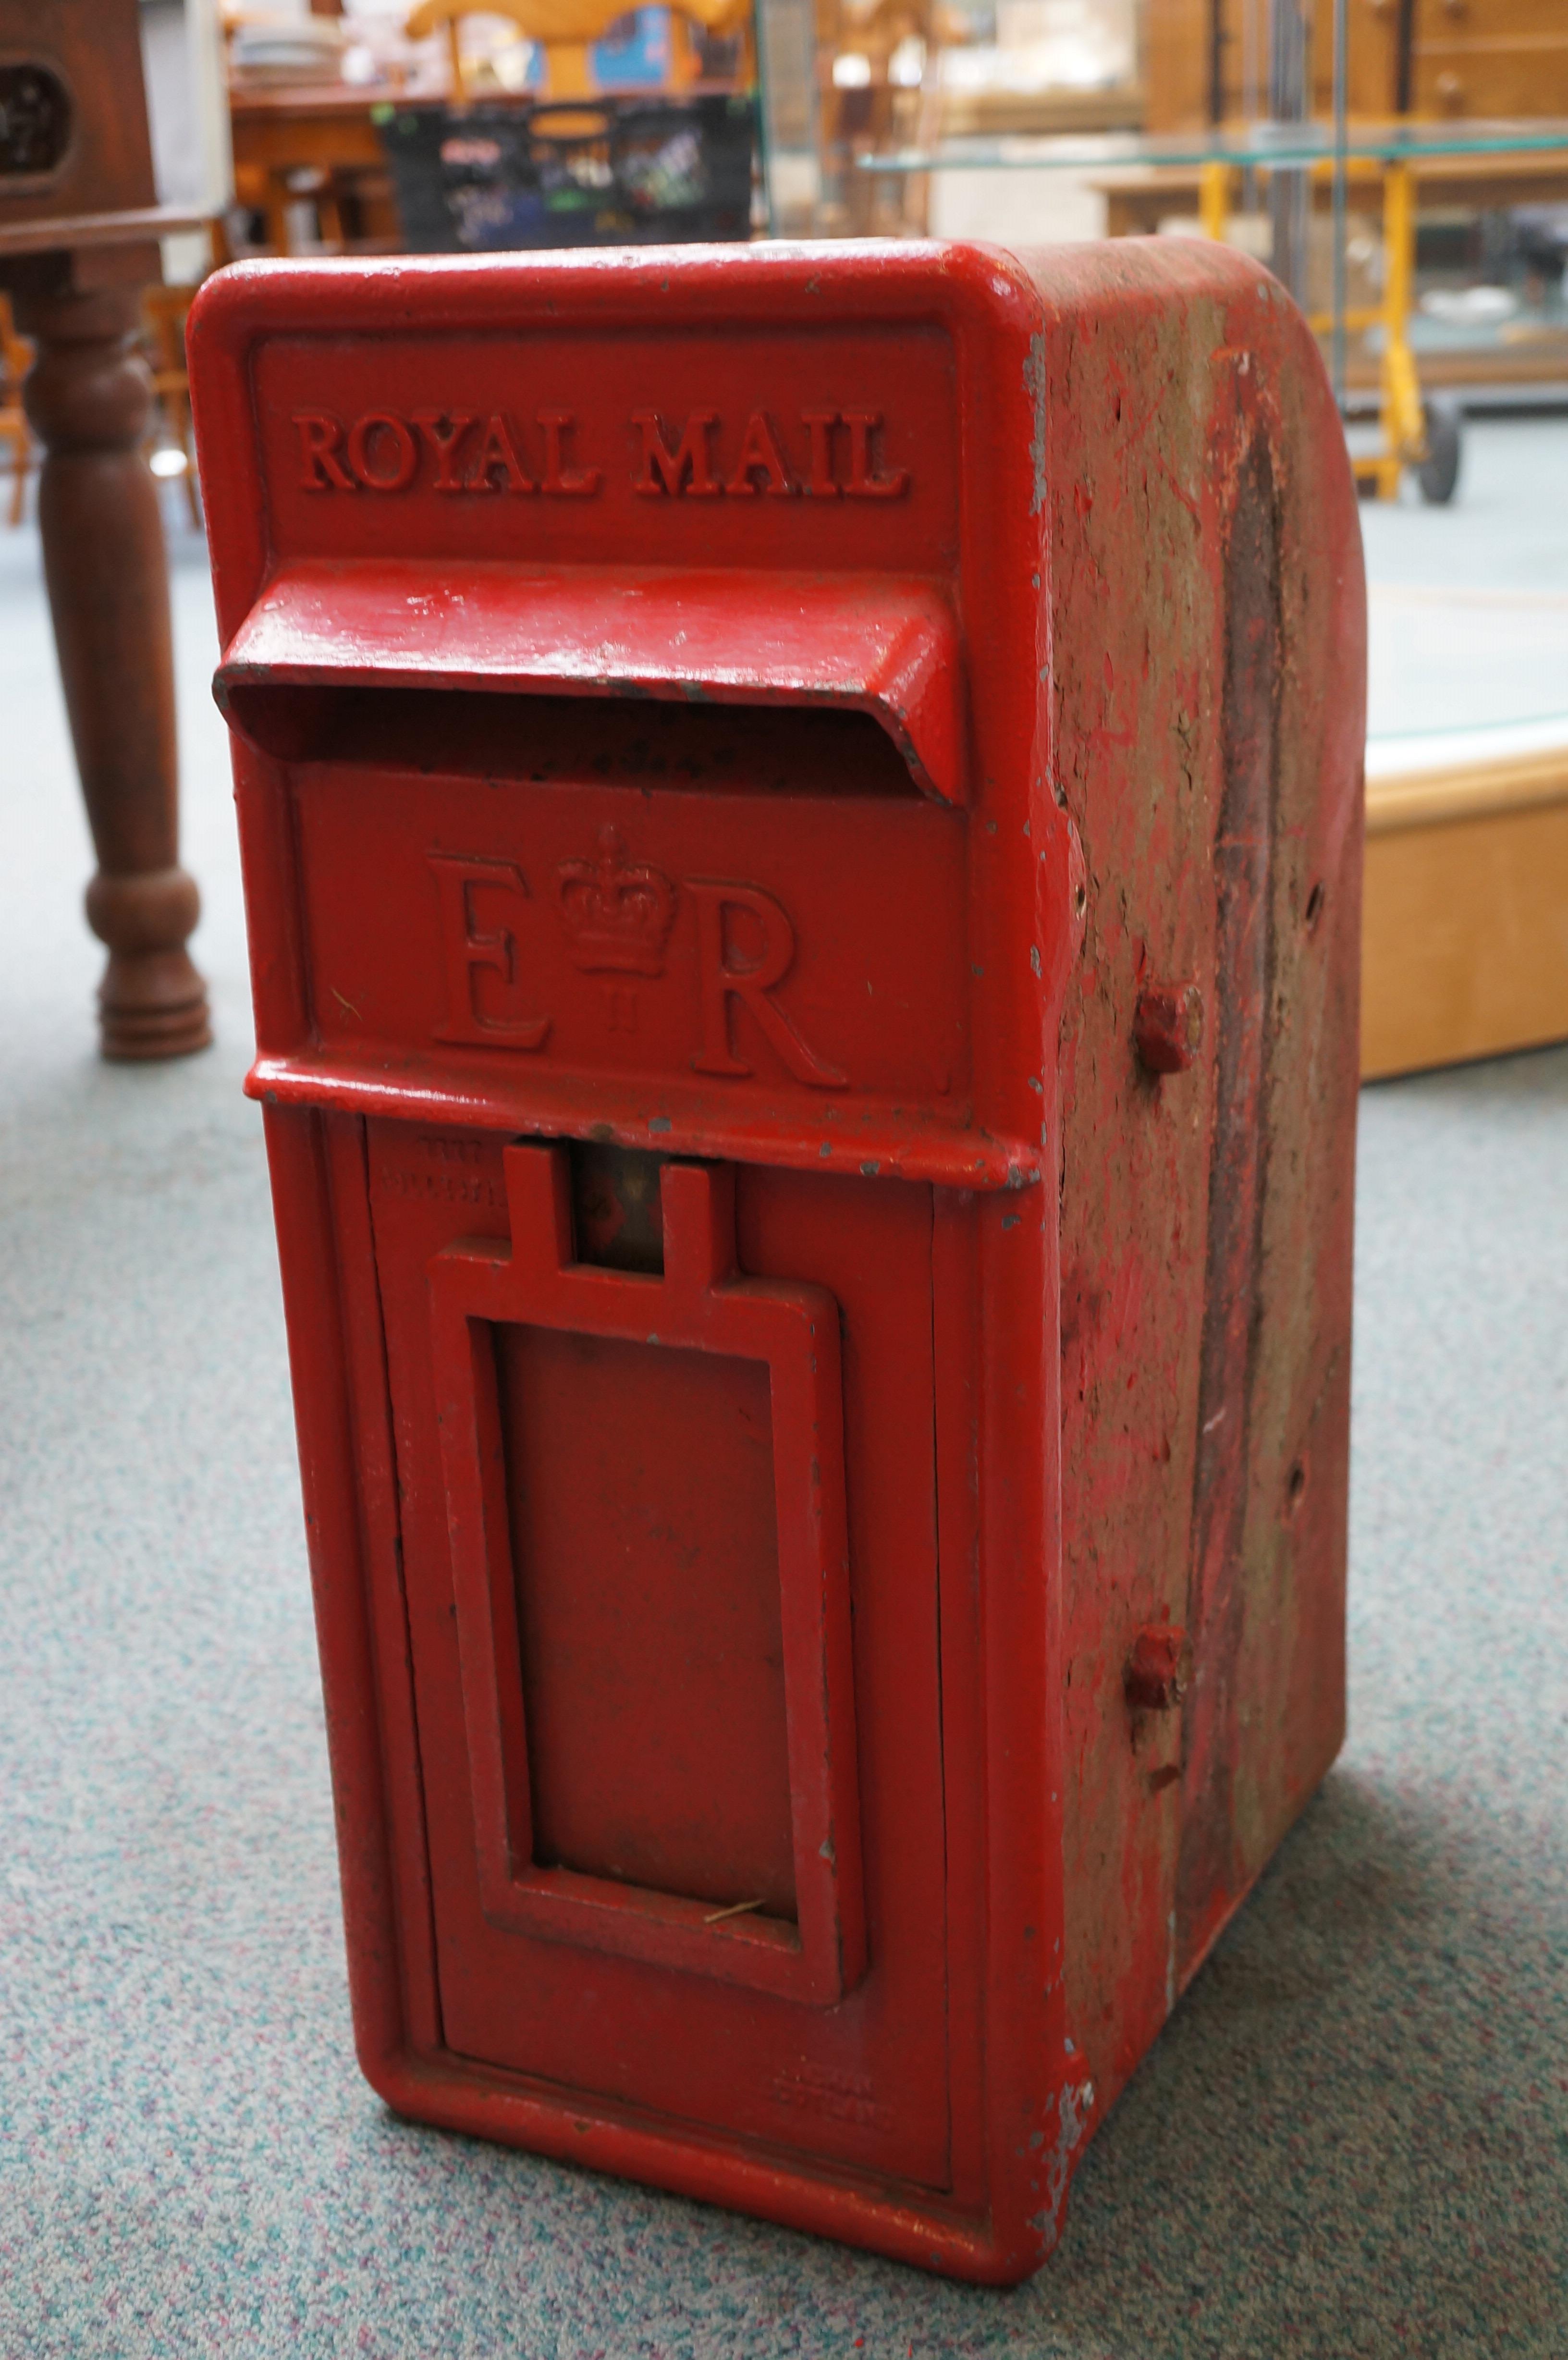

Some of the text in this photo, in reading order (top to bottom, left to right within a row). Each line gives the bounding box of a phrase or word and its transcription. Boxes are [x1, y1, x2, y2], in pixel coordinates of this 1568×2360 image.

[292, 409, 911, 498] ROYAL MAIL
[425, 849, 851, 1092] E R
